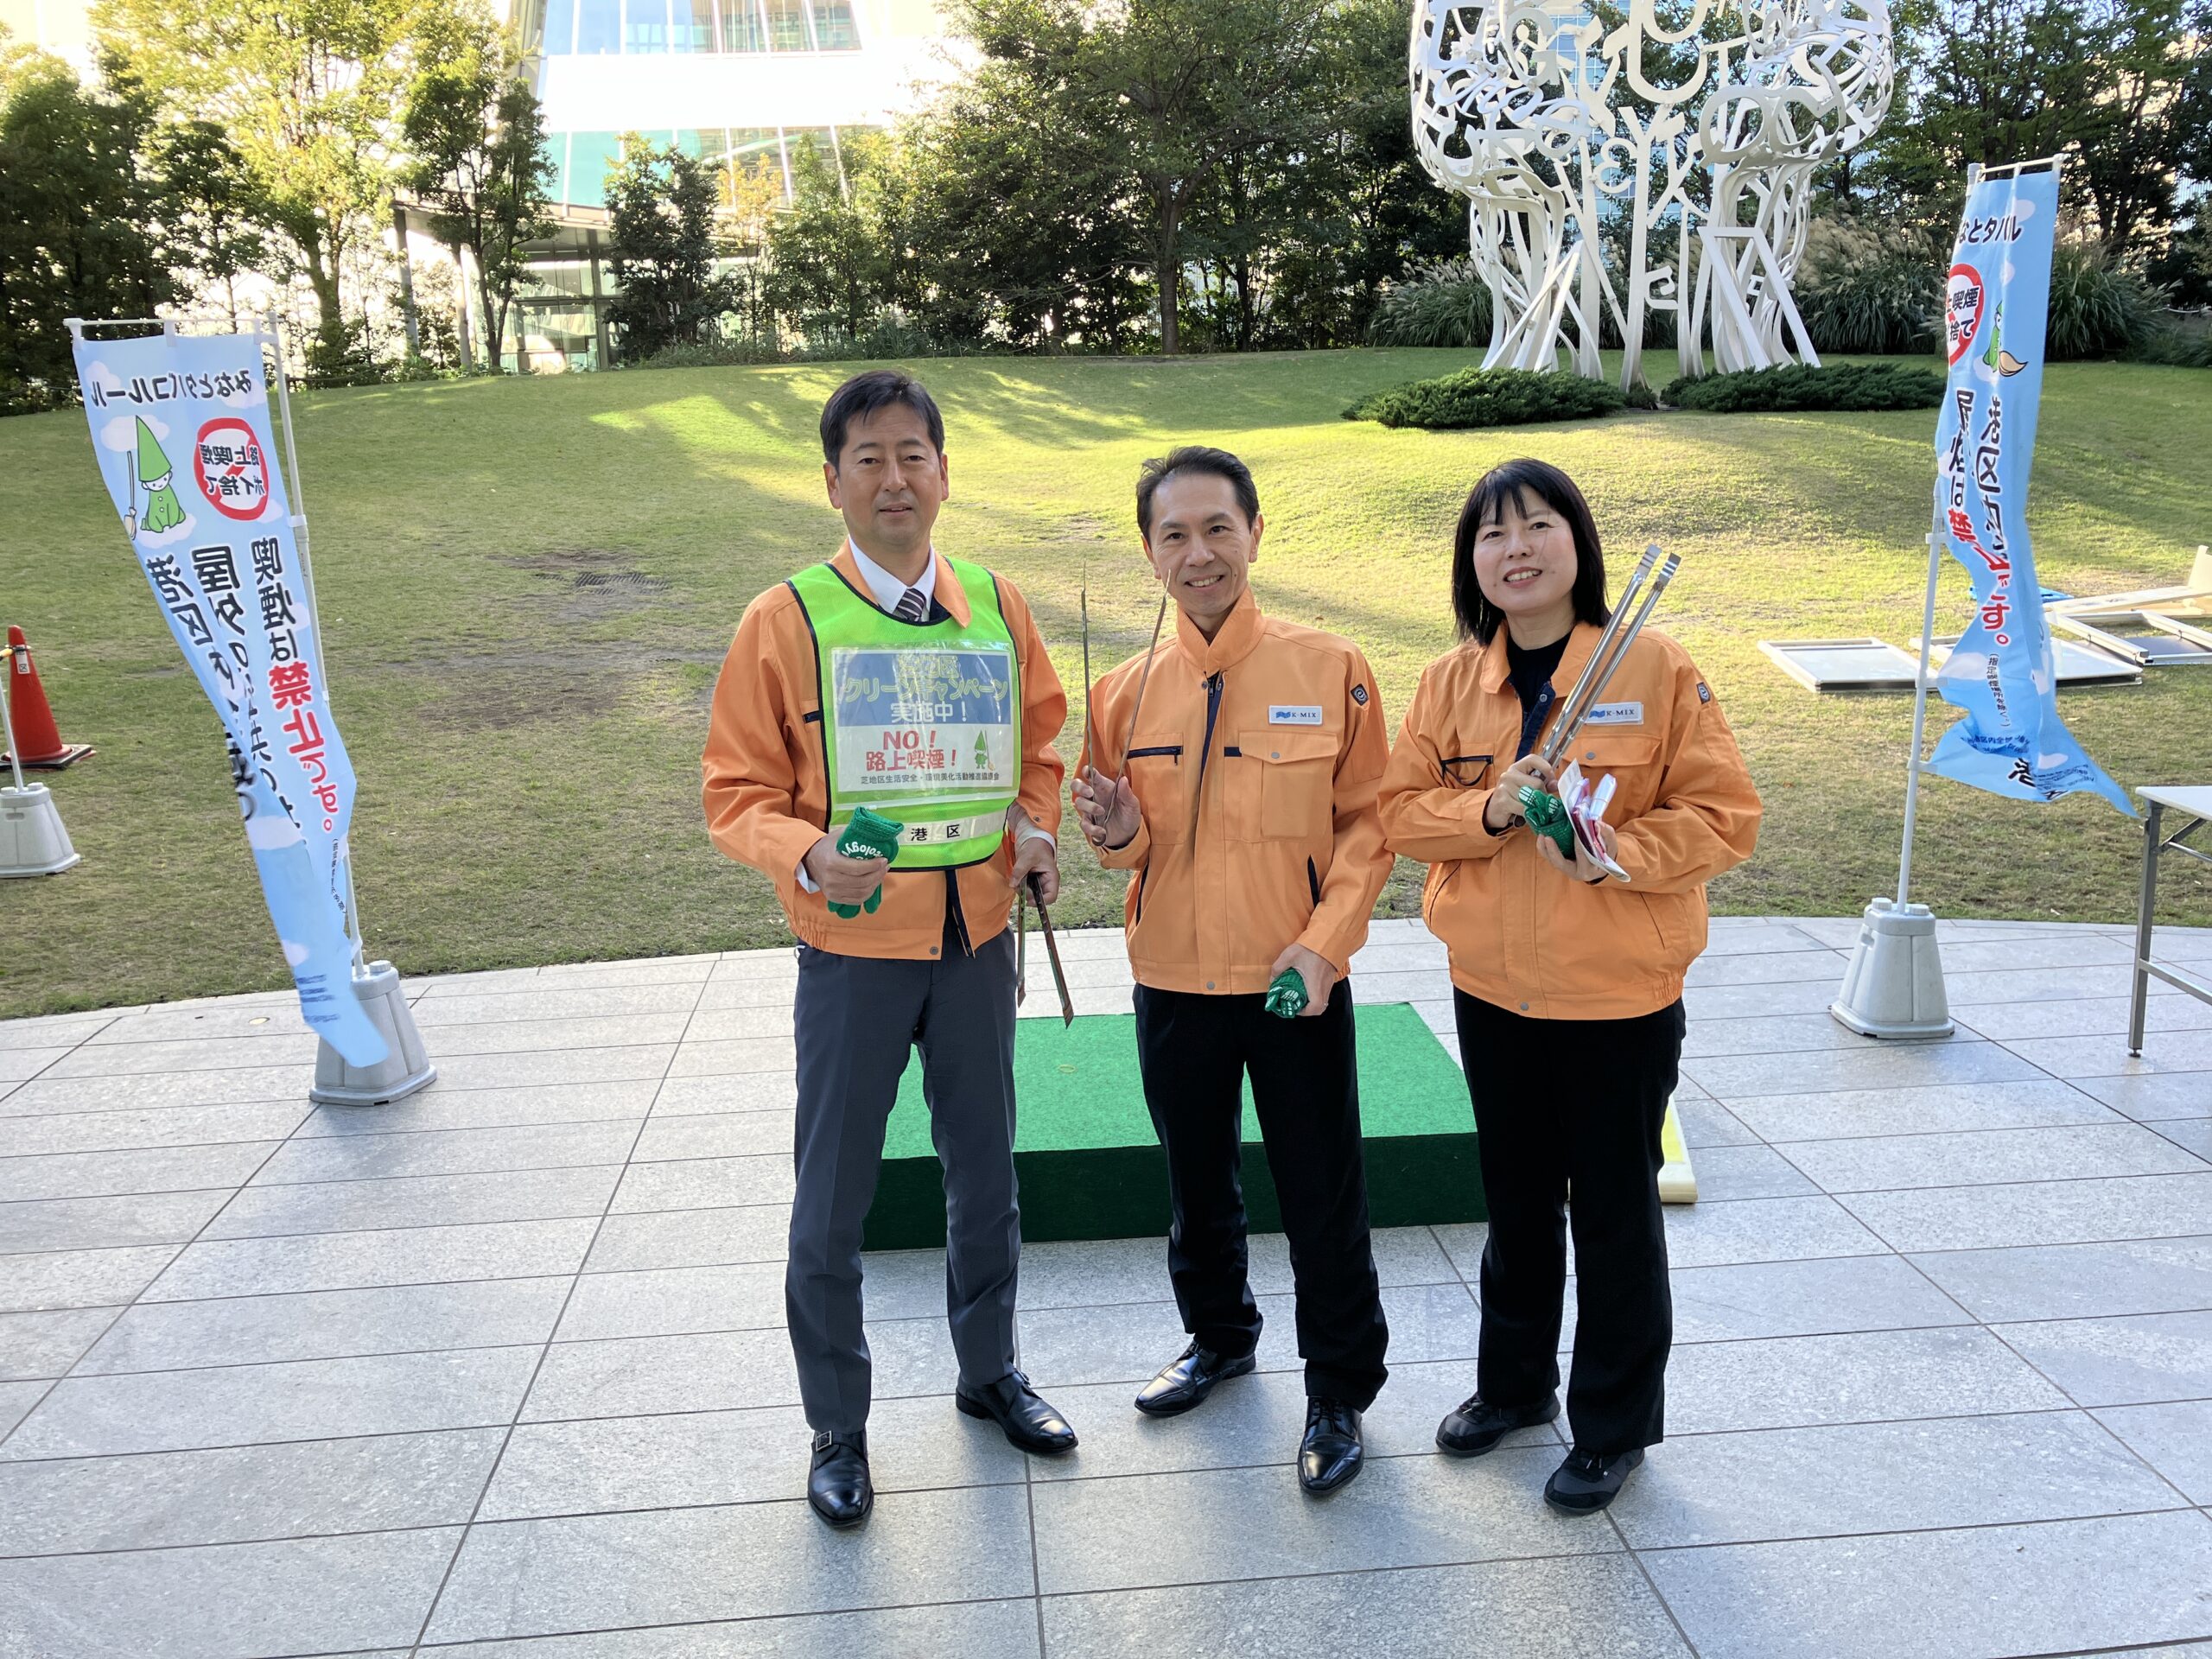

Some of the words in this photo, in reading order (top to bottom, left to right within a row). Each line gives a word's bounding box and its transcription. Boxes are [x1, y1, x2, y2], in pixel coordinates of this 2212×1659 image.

[844, 677, 1008, 702] クリーンキャンペーン
[891, 701, 967, 723] 実施中！
[866, 749, 957, 772] 路上喫煙！
